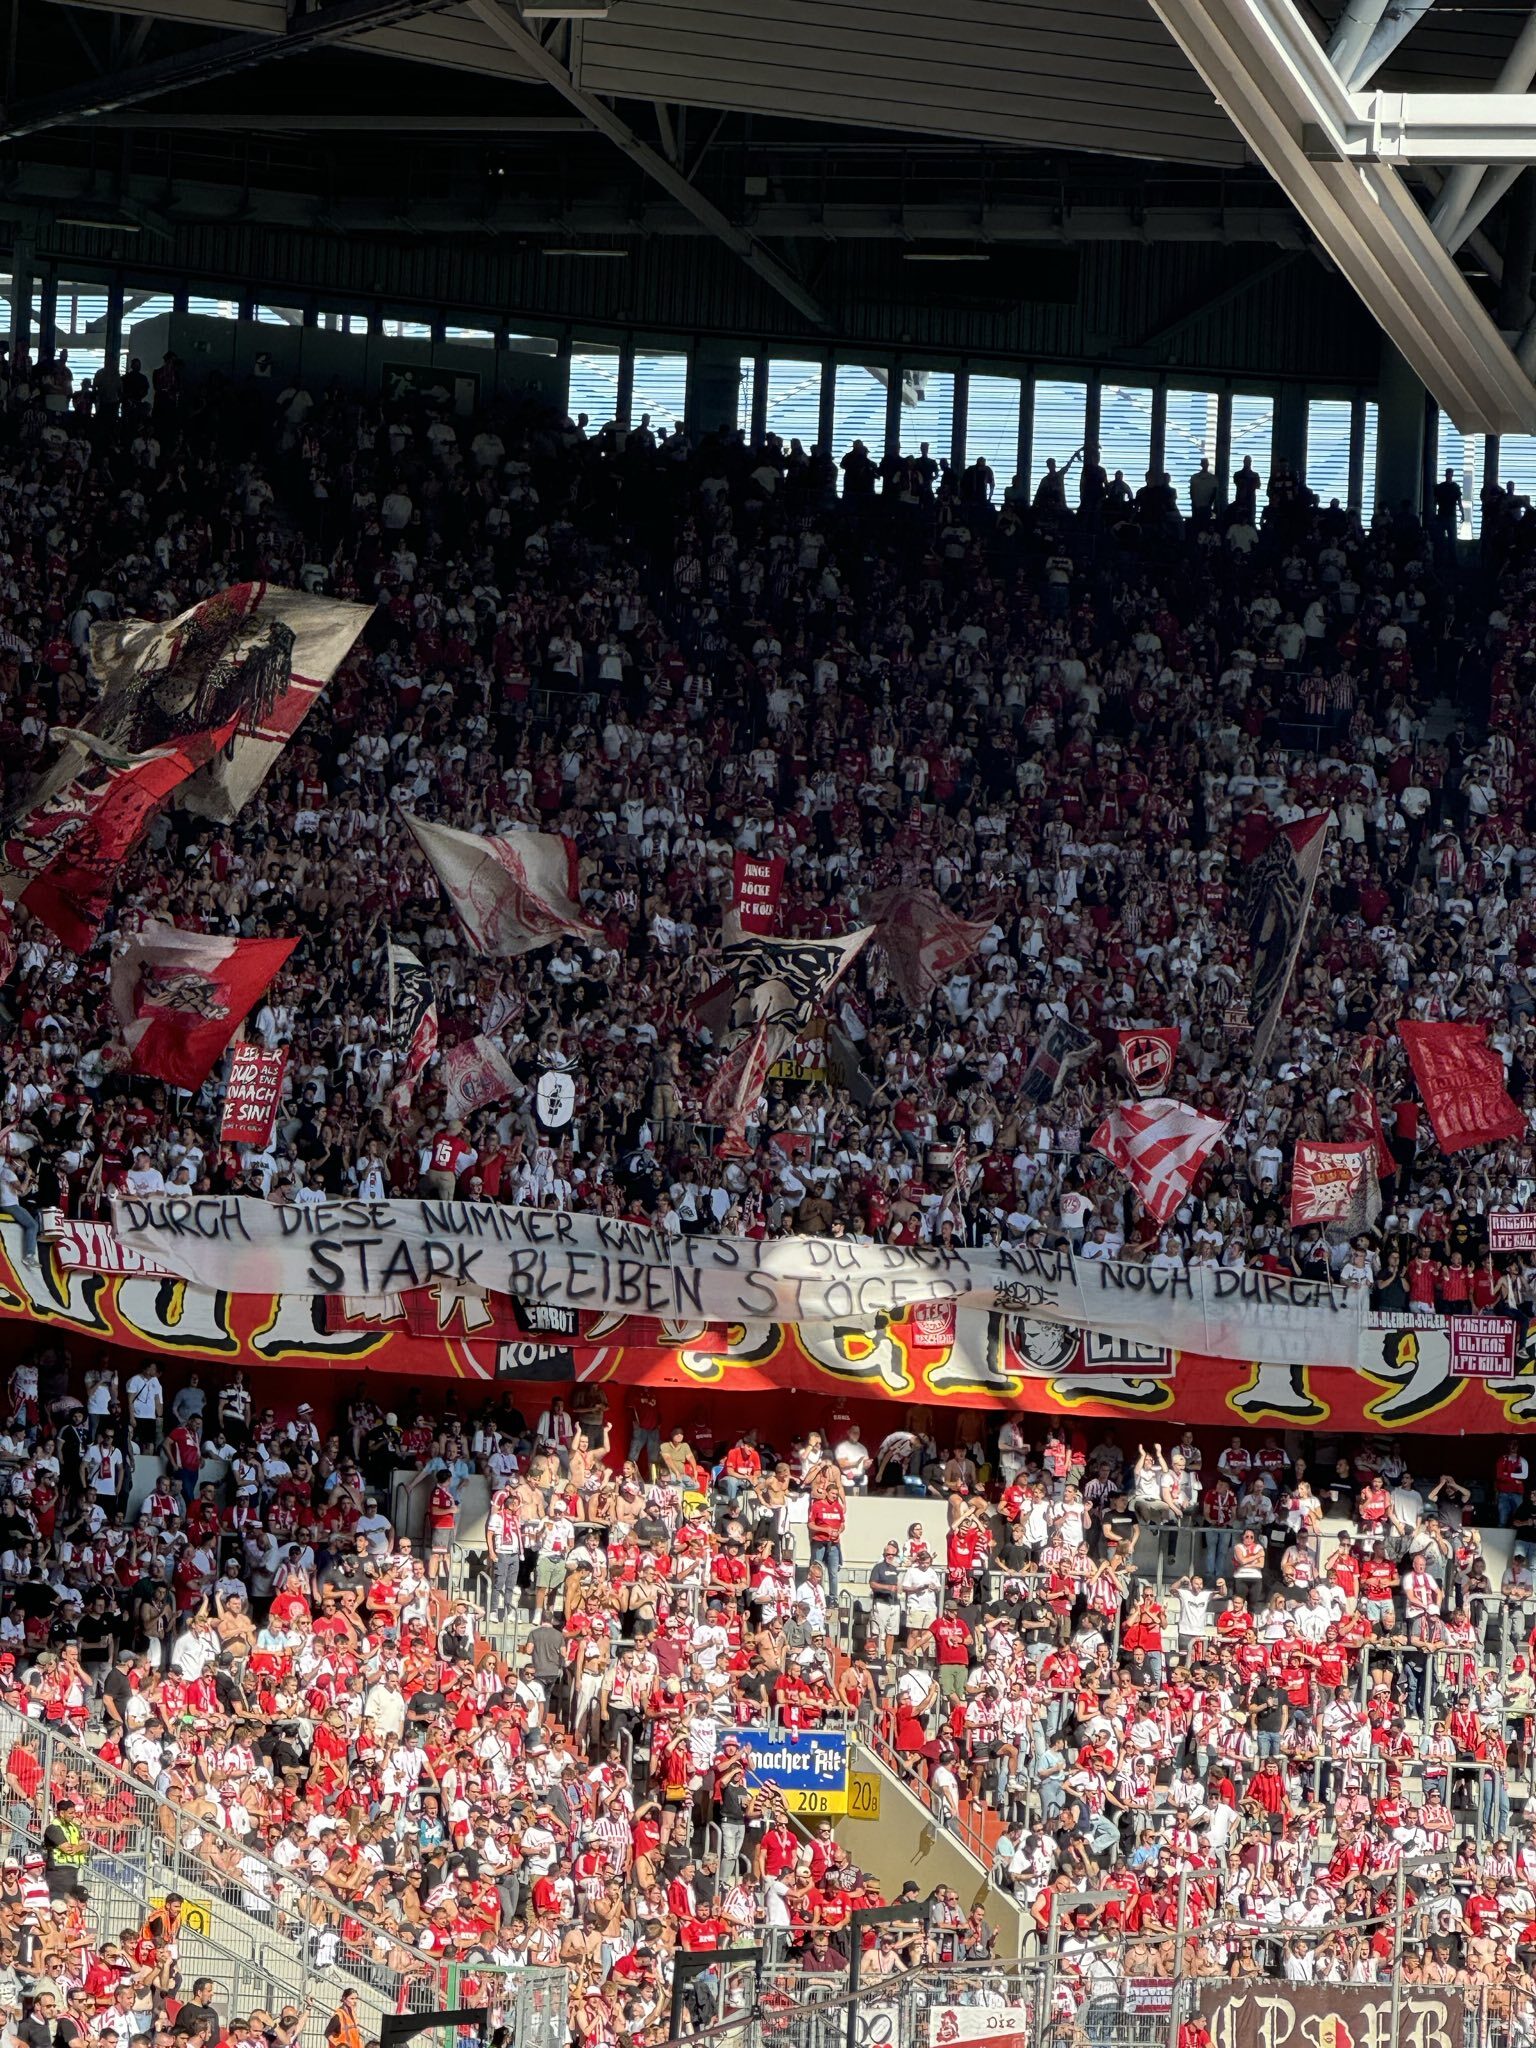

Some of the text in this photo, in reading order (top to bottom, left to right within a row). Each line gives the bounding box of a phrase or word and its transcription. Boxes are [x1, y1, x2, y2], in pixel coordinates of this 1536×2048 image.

[744, 863, 770, 877] JUNGE
[741, 881, 770, 896] BÖCKE
[741, 900, 751, 914] FC
[237, 1103, 271, 1124] SIN!
[435, 1143, 453, 1163] 15
[122, 1200, 1349, 1313] DURCH DIESE NUMMER KÄMPFST DU DICH AUCH NOCH DURCH!
[308, 1238, 485, 1292] STARK
[508, 1246, 704, 1315] BLEIBEN
[1458, 1335, 1506, 1354] ULTRAS
[986, 2013, 1016, 2029] Die
